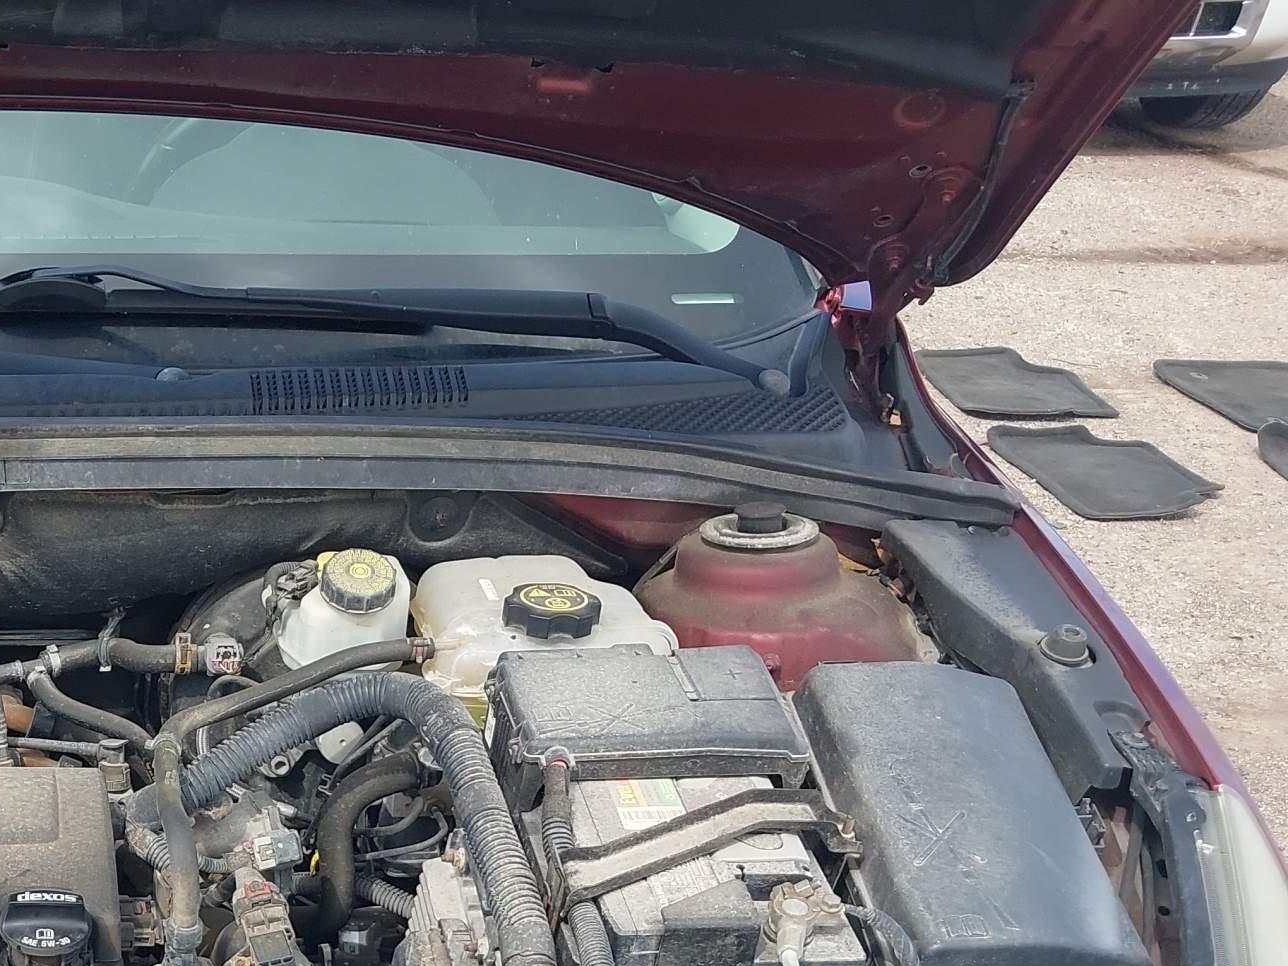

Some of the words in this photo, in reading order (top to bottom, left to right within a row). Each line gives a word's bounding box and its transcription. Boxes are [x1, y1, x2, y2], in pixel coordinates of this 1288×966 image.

[16, 891, 79, 902] dexos
[21, 936, 39, 947] SAE
[40, 936, 71, 948] 5W-30
